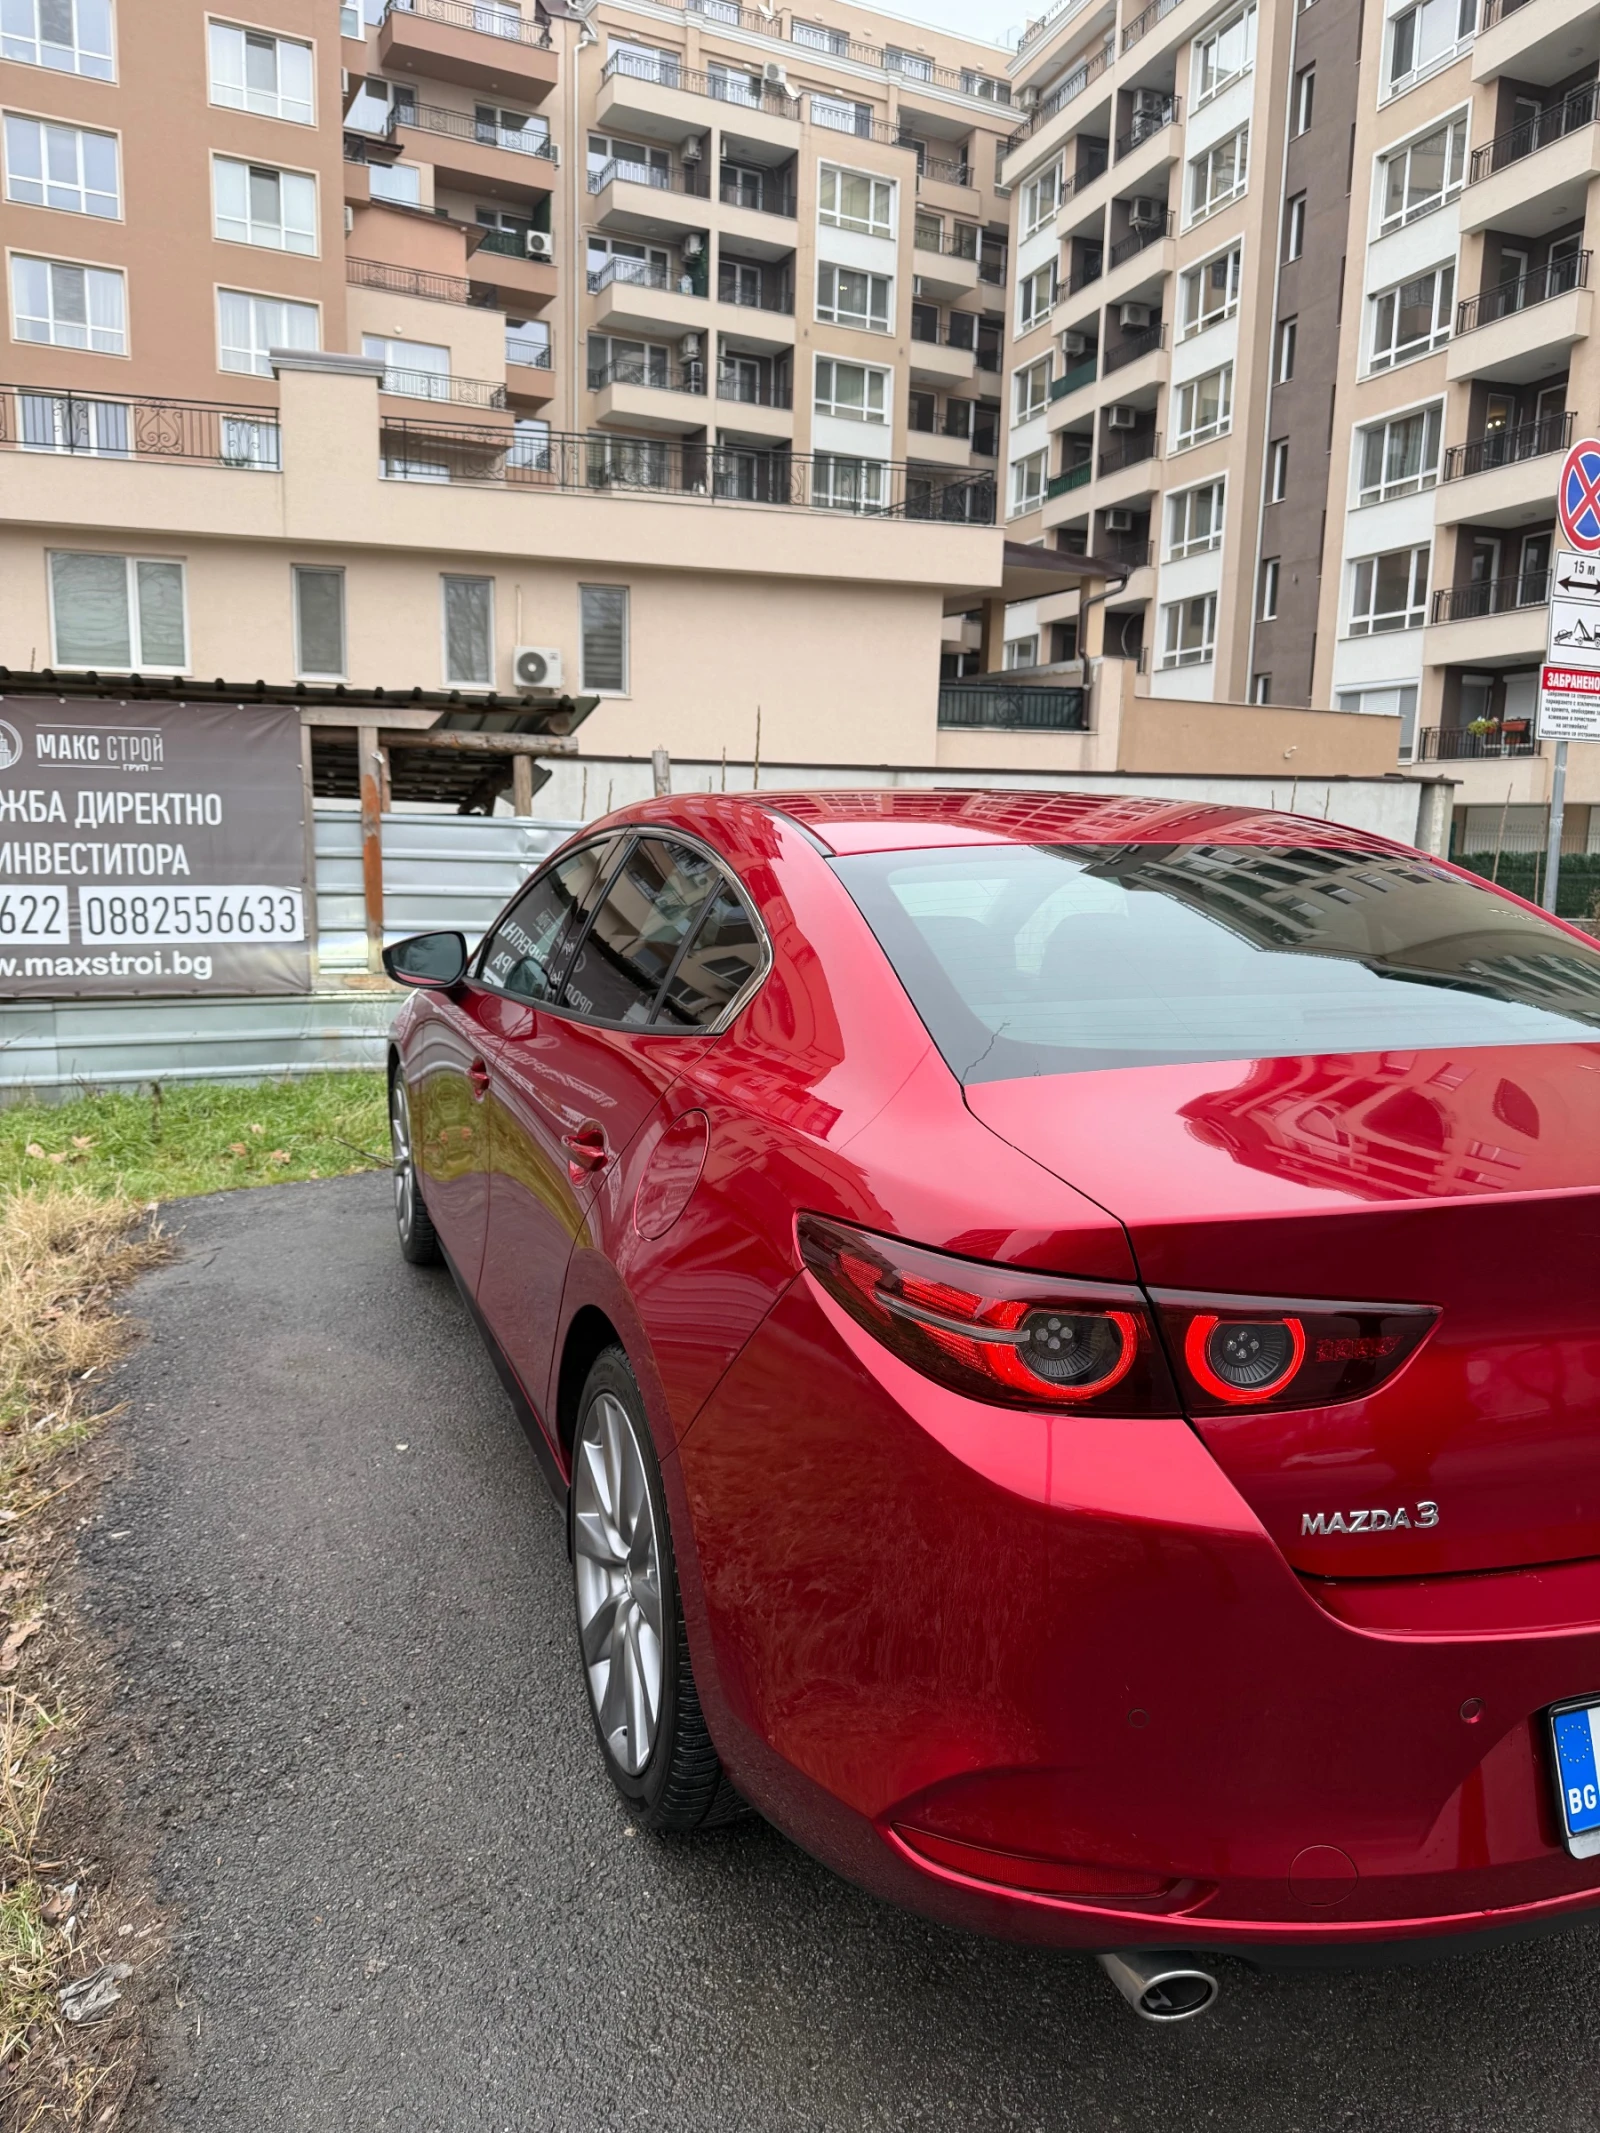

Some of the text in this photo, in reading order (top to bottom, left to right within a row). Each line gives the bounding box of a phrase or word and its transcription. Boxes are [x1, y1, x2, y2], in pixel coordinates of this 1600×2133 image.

[1574, 560, 1585, 574] 15
[1547, 673, 1600, 691] ЗАБРАНЕНО
[36, 733, 164, 763] МАКС СТРОЙ
[122, 763, 149, 772] ГРУП
[74, 791, 223, 829] ДИРЕКТНО
[0, 895, 296, 936] 622 0882556633
[1567, 1784, 1597, 1815] BG
